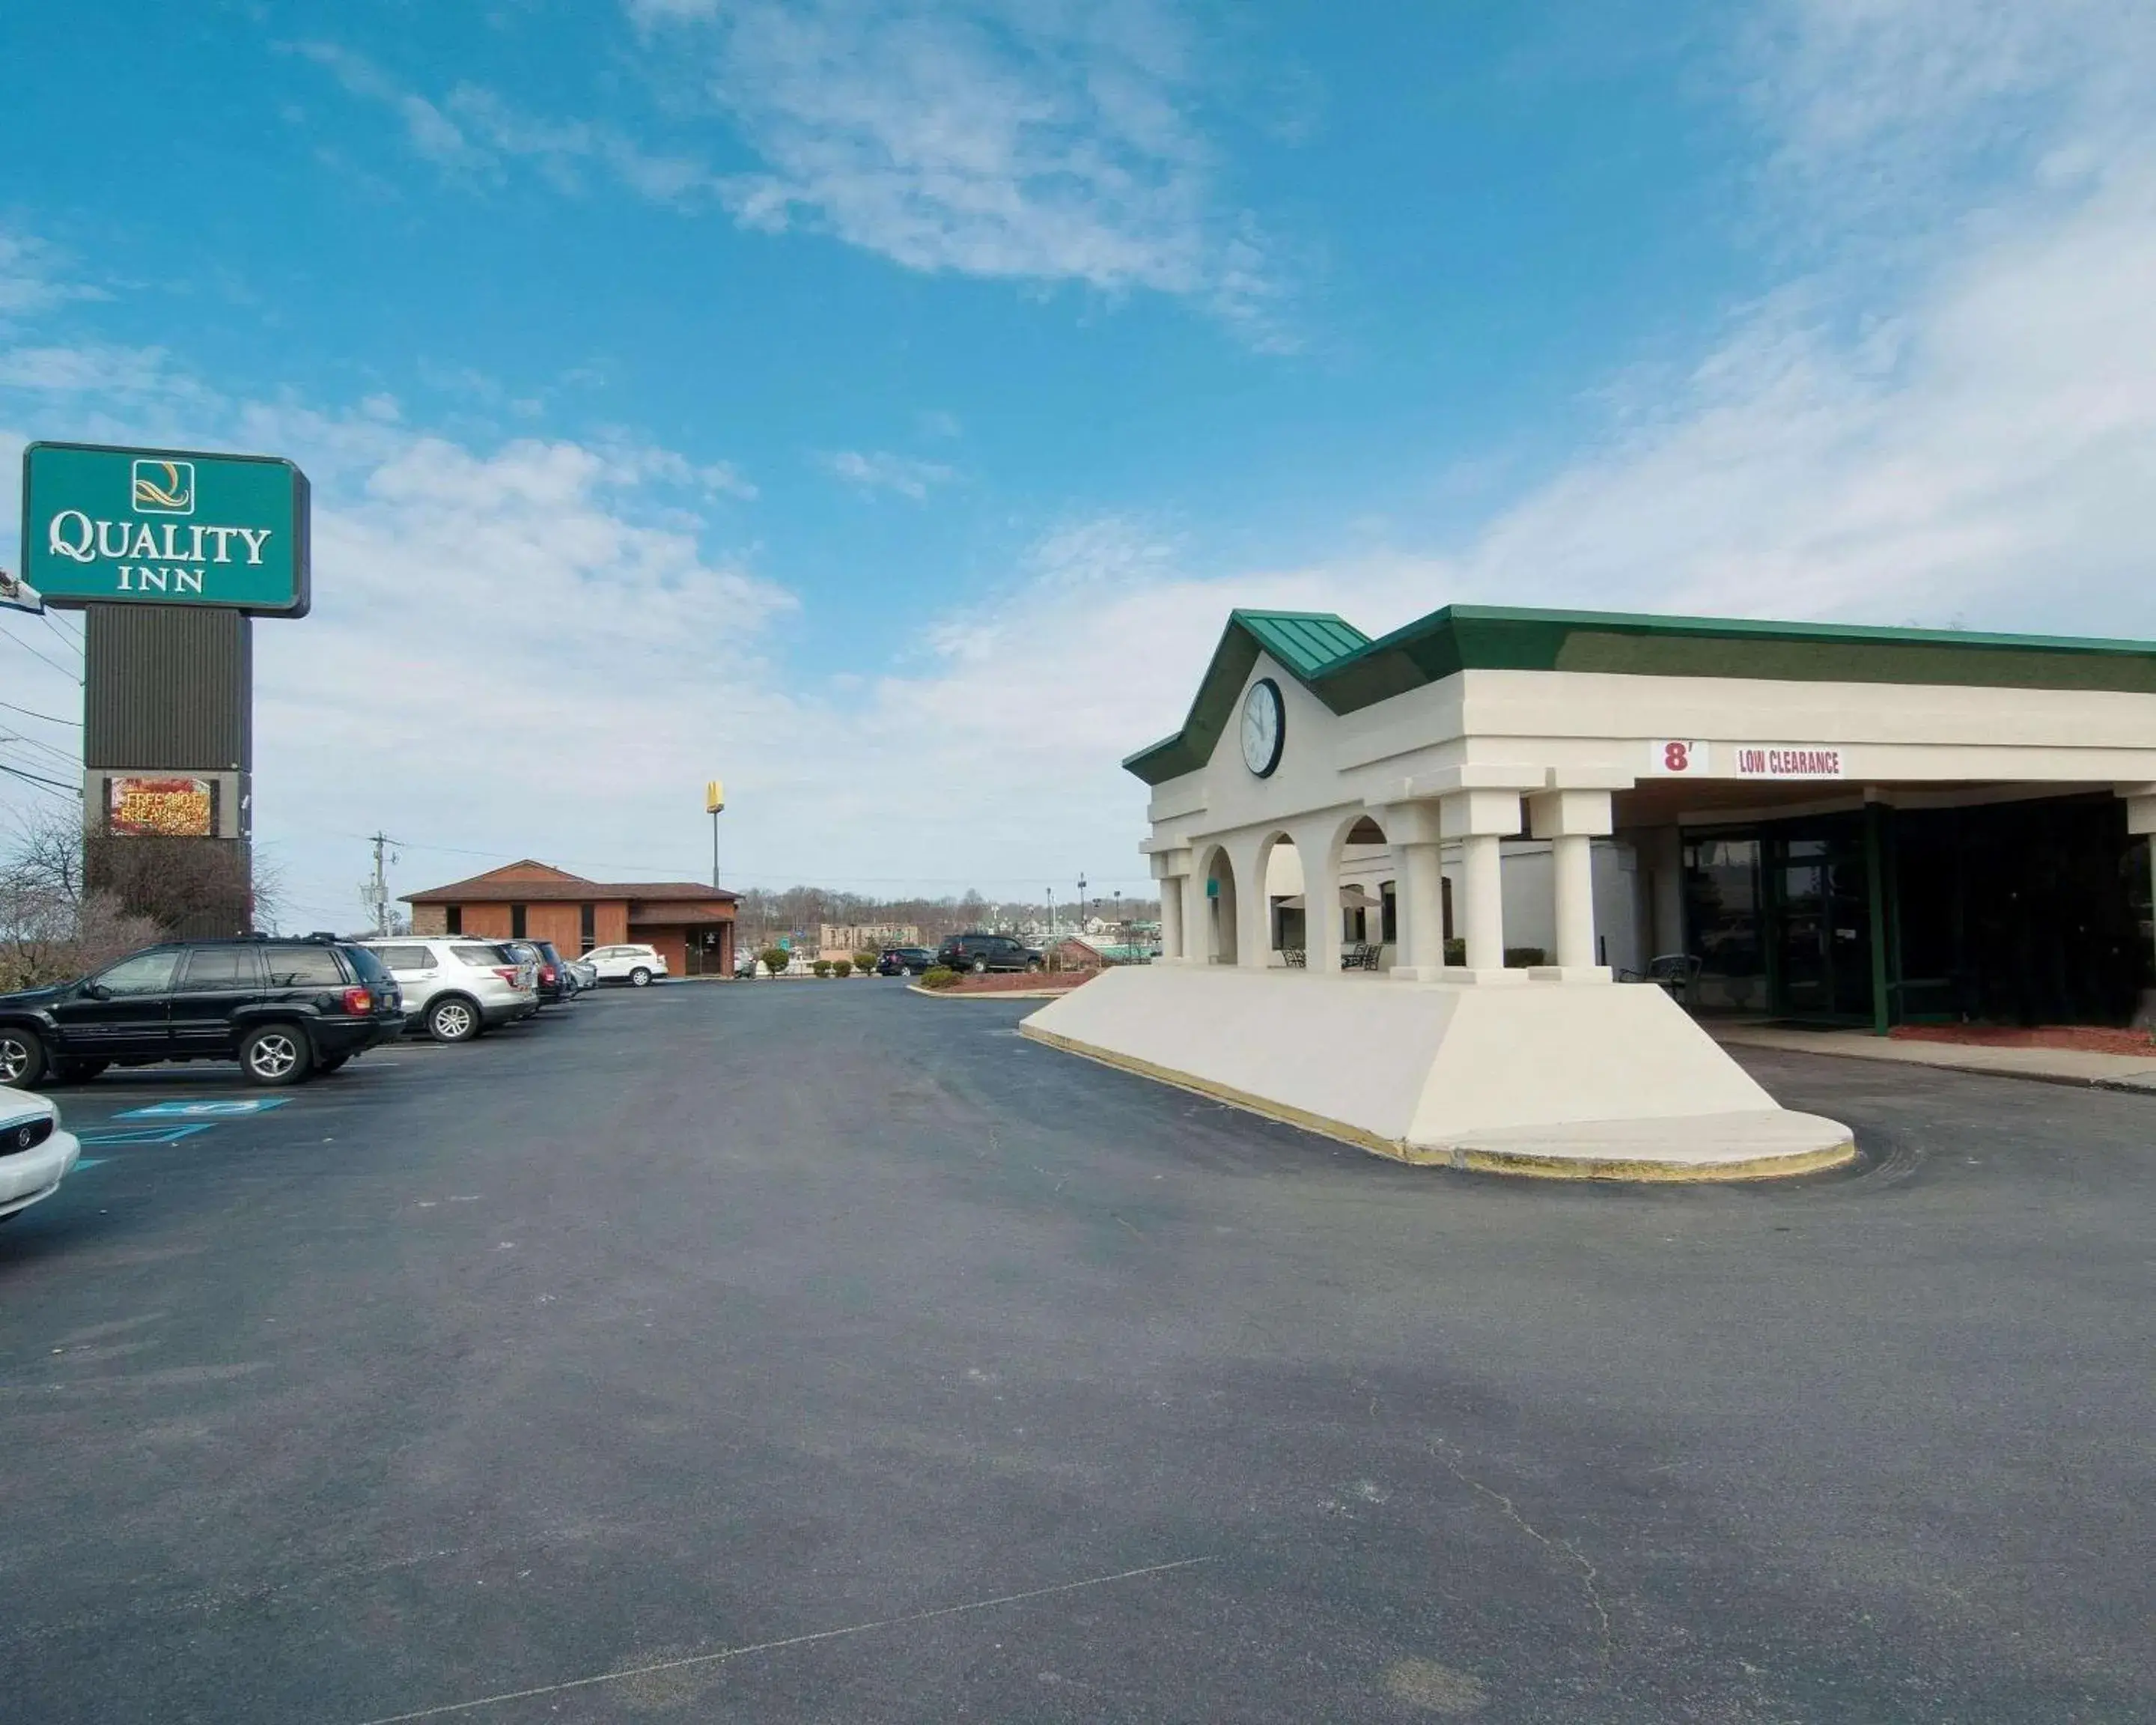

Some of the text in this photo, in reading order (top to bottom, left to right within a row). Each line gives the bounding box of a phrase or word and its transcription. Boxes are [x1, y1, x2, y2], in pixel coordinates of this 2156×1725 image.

[49, 510, 272, 564] QUALITY
[117, 566, 204, 594] INN
[1738, 749, 1839, 774] LOW CLEARANCE
[127, 793, 165, 808] FREE
